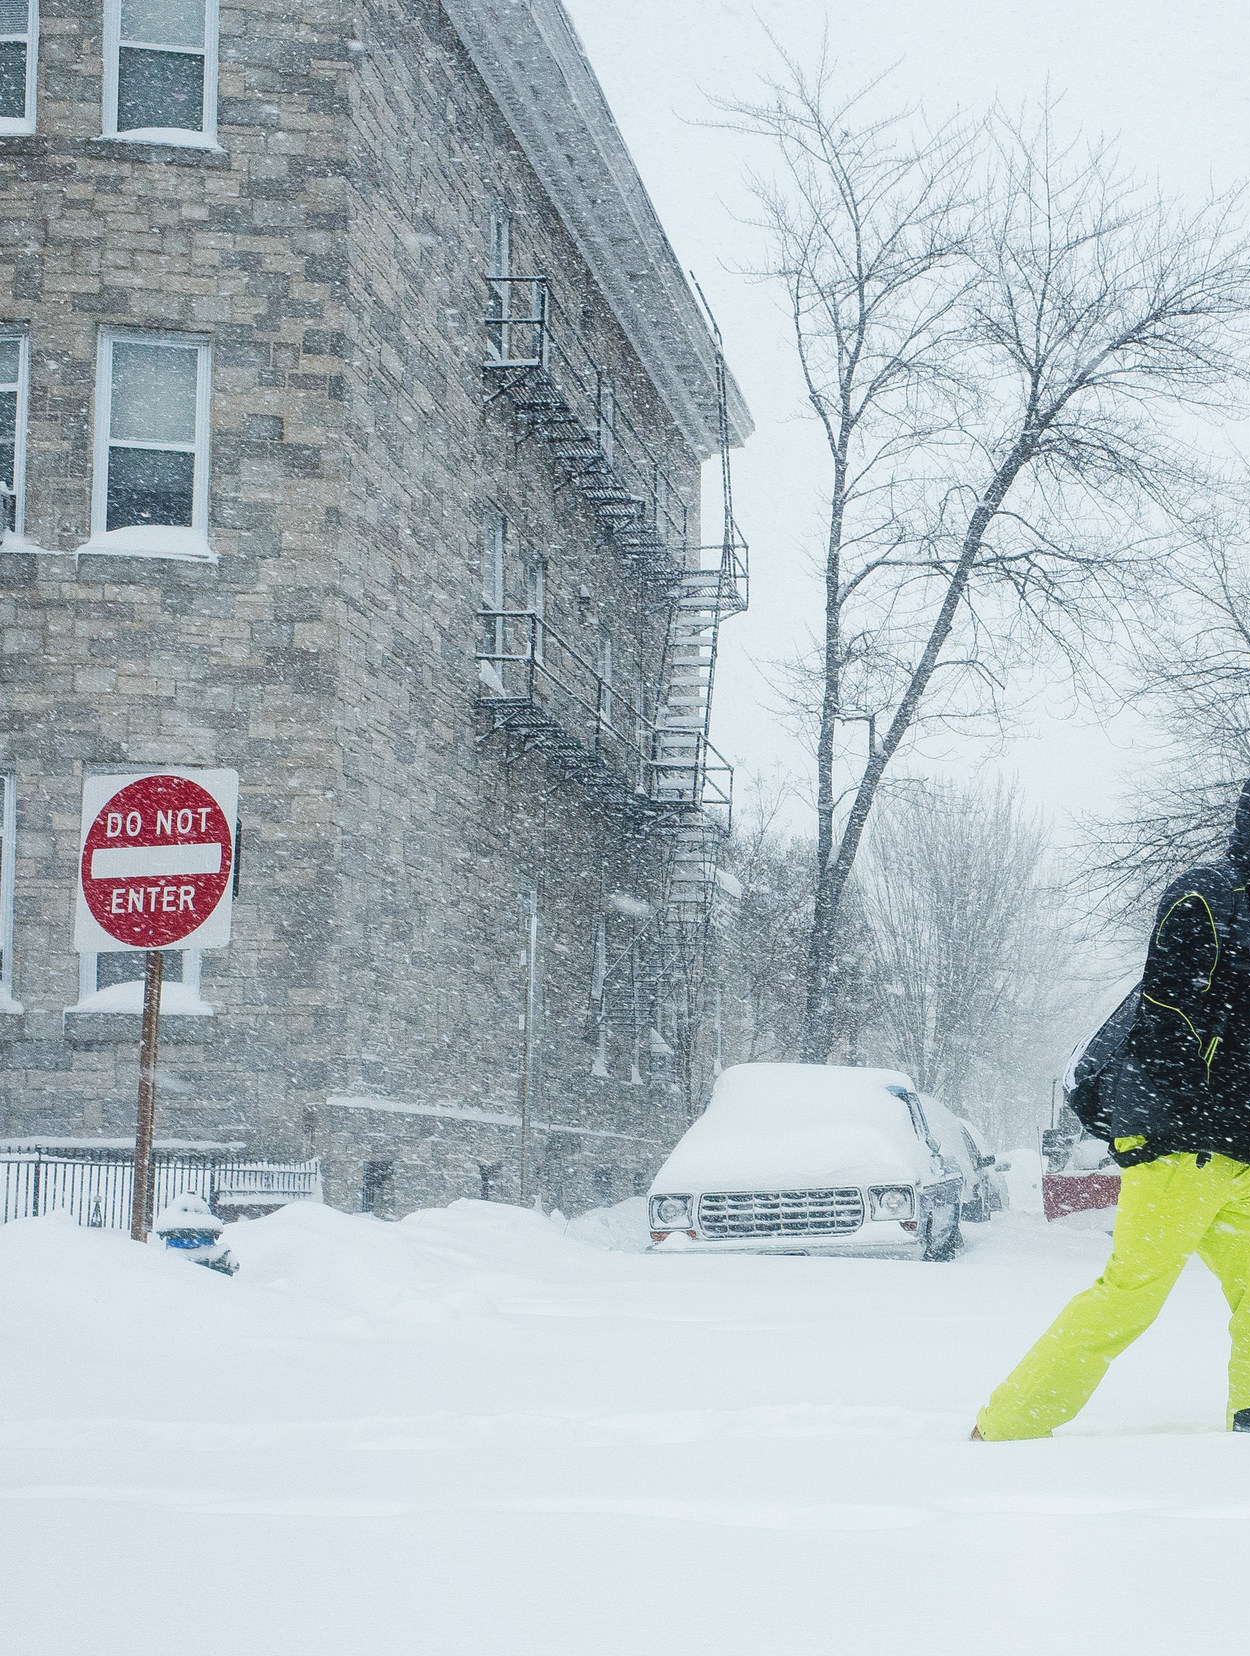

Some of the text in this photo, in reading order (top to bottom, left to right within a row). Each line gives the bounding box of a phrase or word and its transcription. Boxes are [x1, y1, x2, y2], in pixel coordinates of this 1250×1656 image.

[107, 807, 211, 837] DO NOT
[111, 886, 195, 913] ENTER
